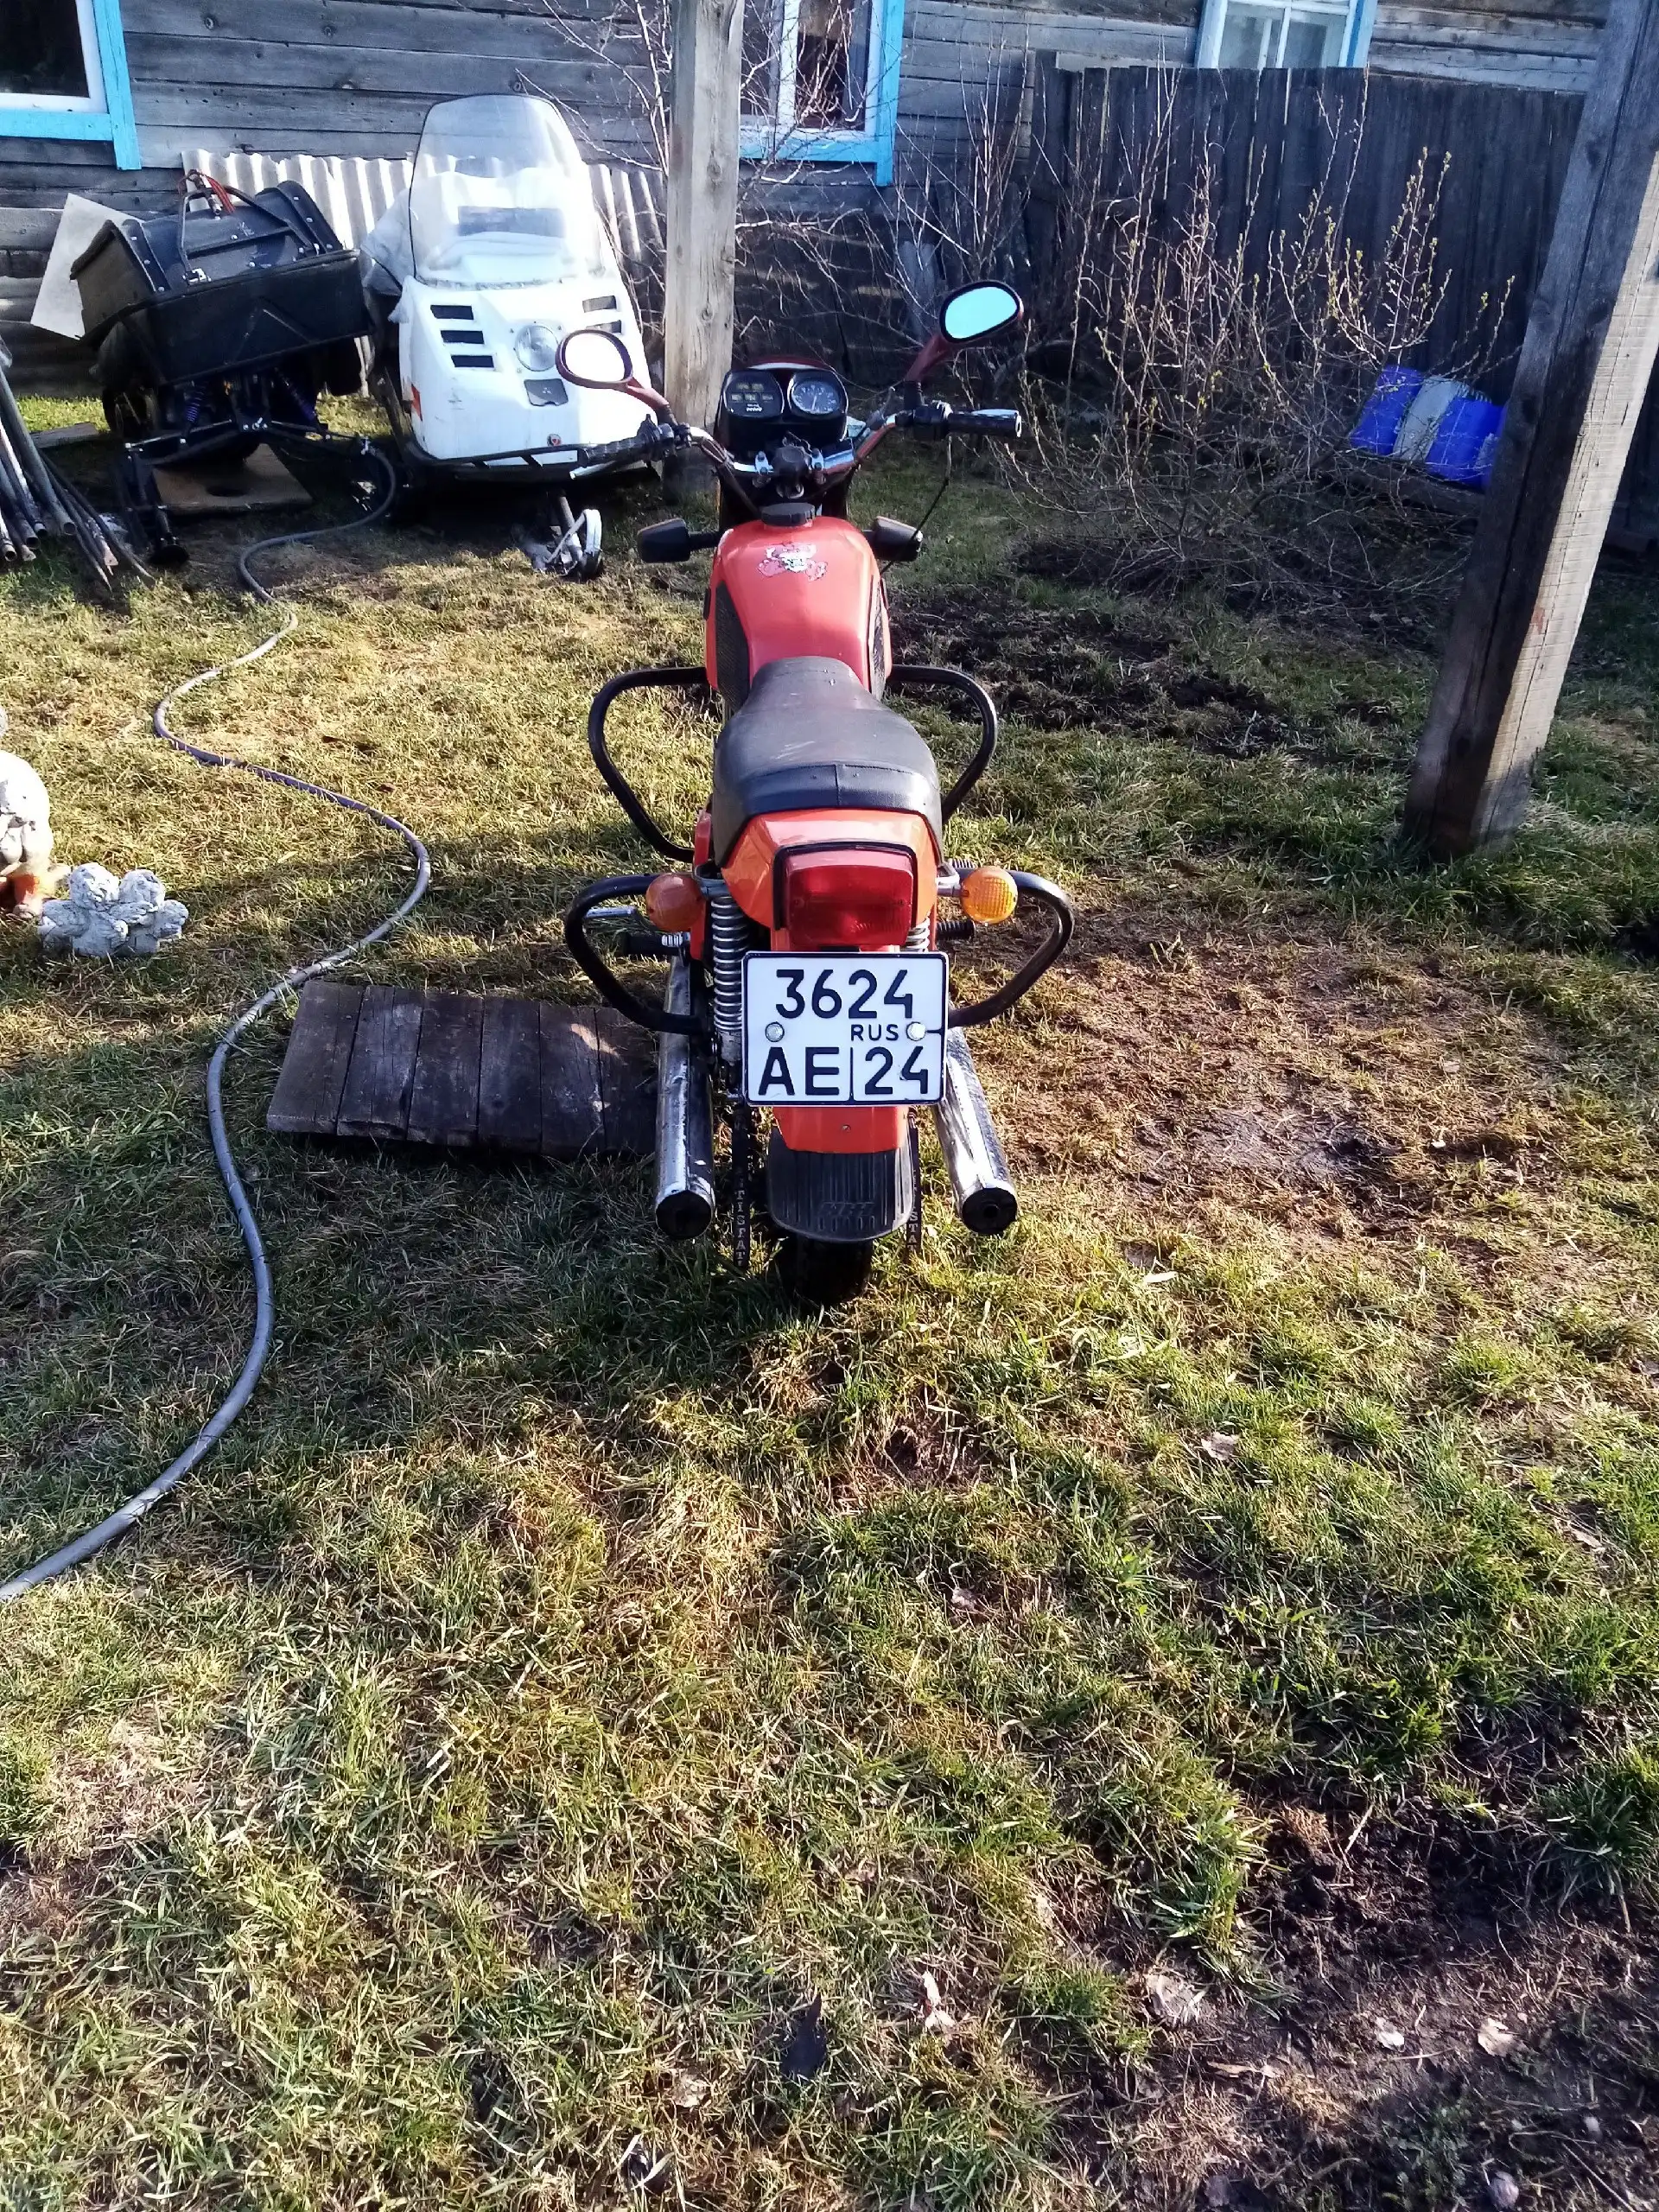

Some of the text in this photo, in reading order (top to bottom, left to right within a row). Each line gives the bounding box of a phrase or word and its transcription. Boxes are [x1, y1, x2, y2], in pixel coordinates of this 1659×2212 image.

[775, 969, 913, 1019] 3624
[850, 1024, 899, 1041] RUS
[758, 1046, 929, 1096] AE 24
